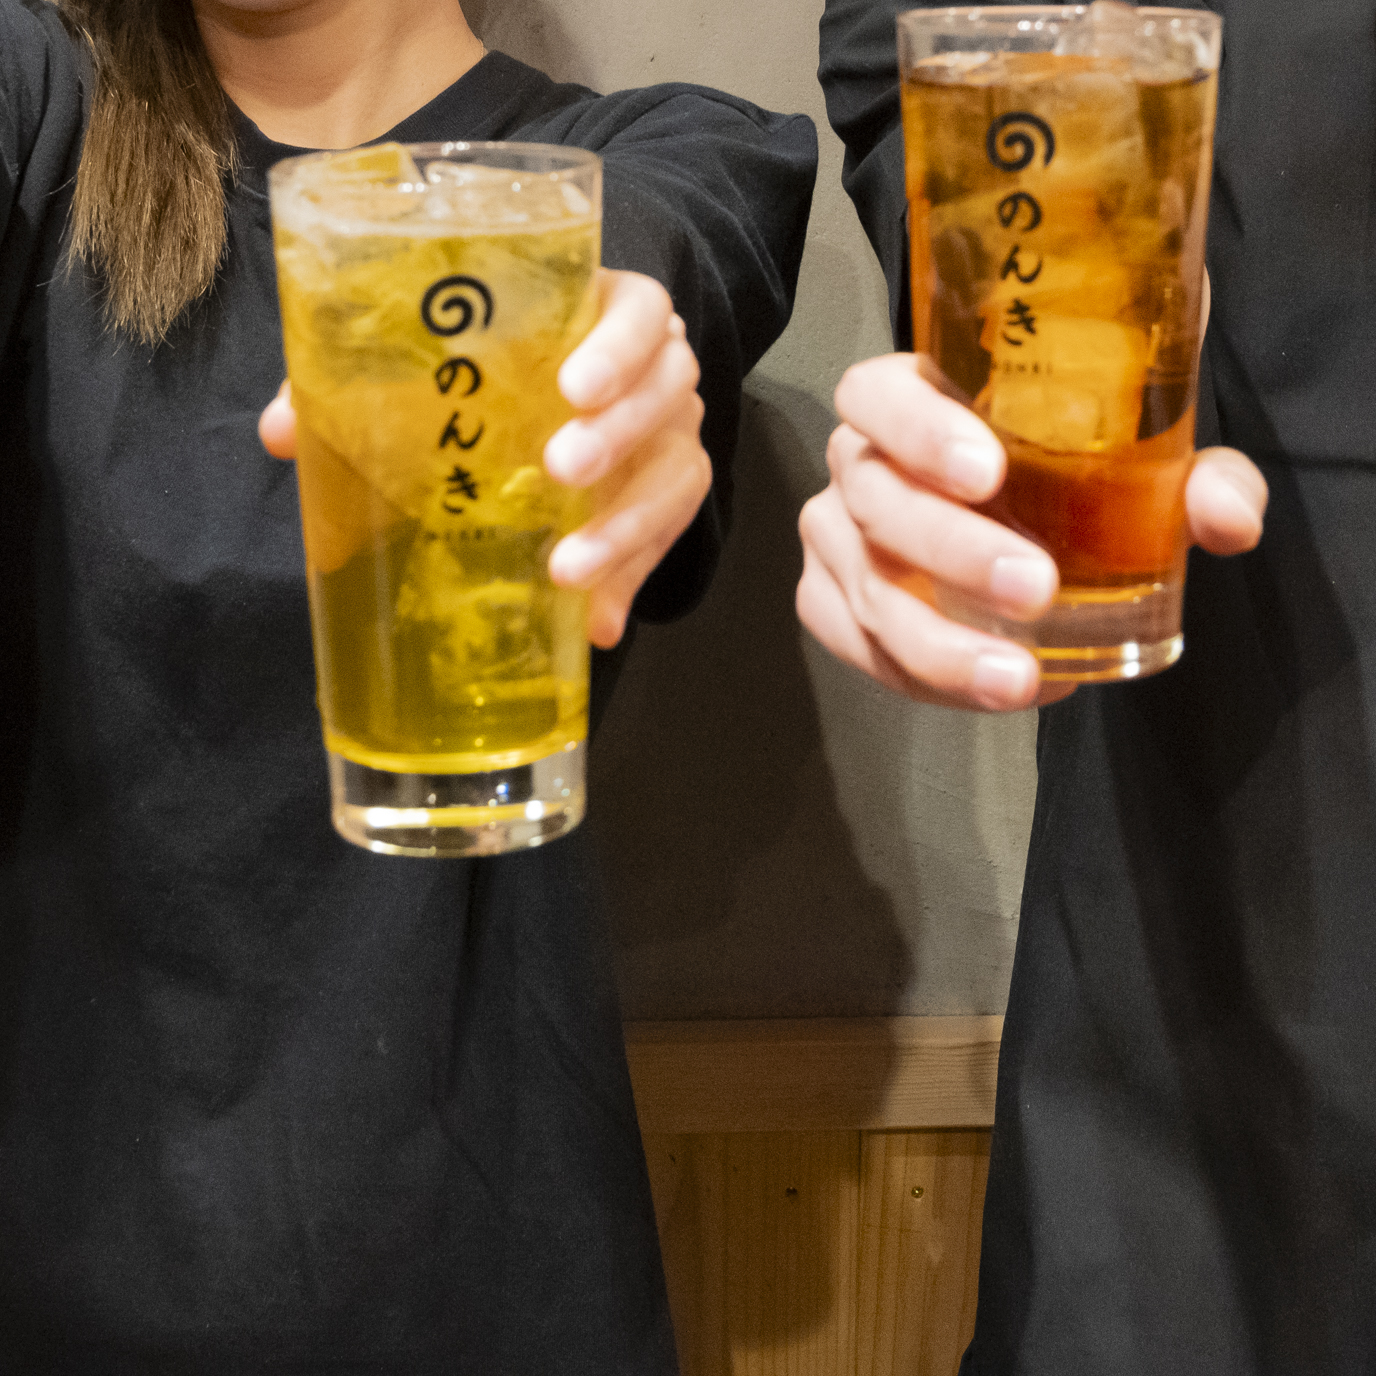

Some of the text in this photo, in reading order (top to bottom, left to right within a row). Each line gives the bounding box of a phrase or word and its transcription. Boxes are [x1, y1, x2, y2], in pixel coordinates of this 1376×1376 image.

[996, 191, 1043, 346] のんき
[435, 356, 484, 514] のんき
